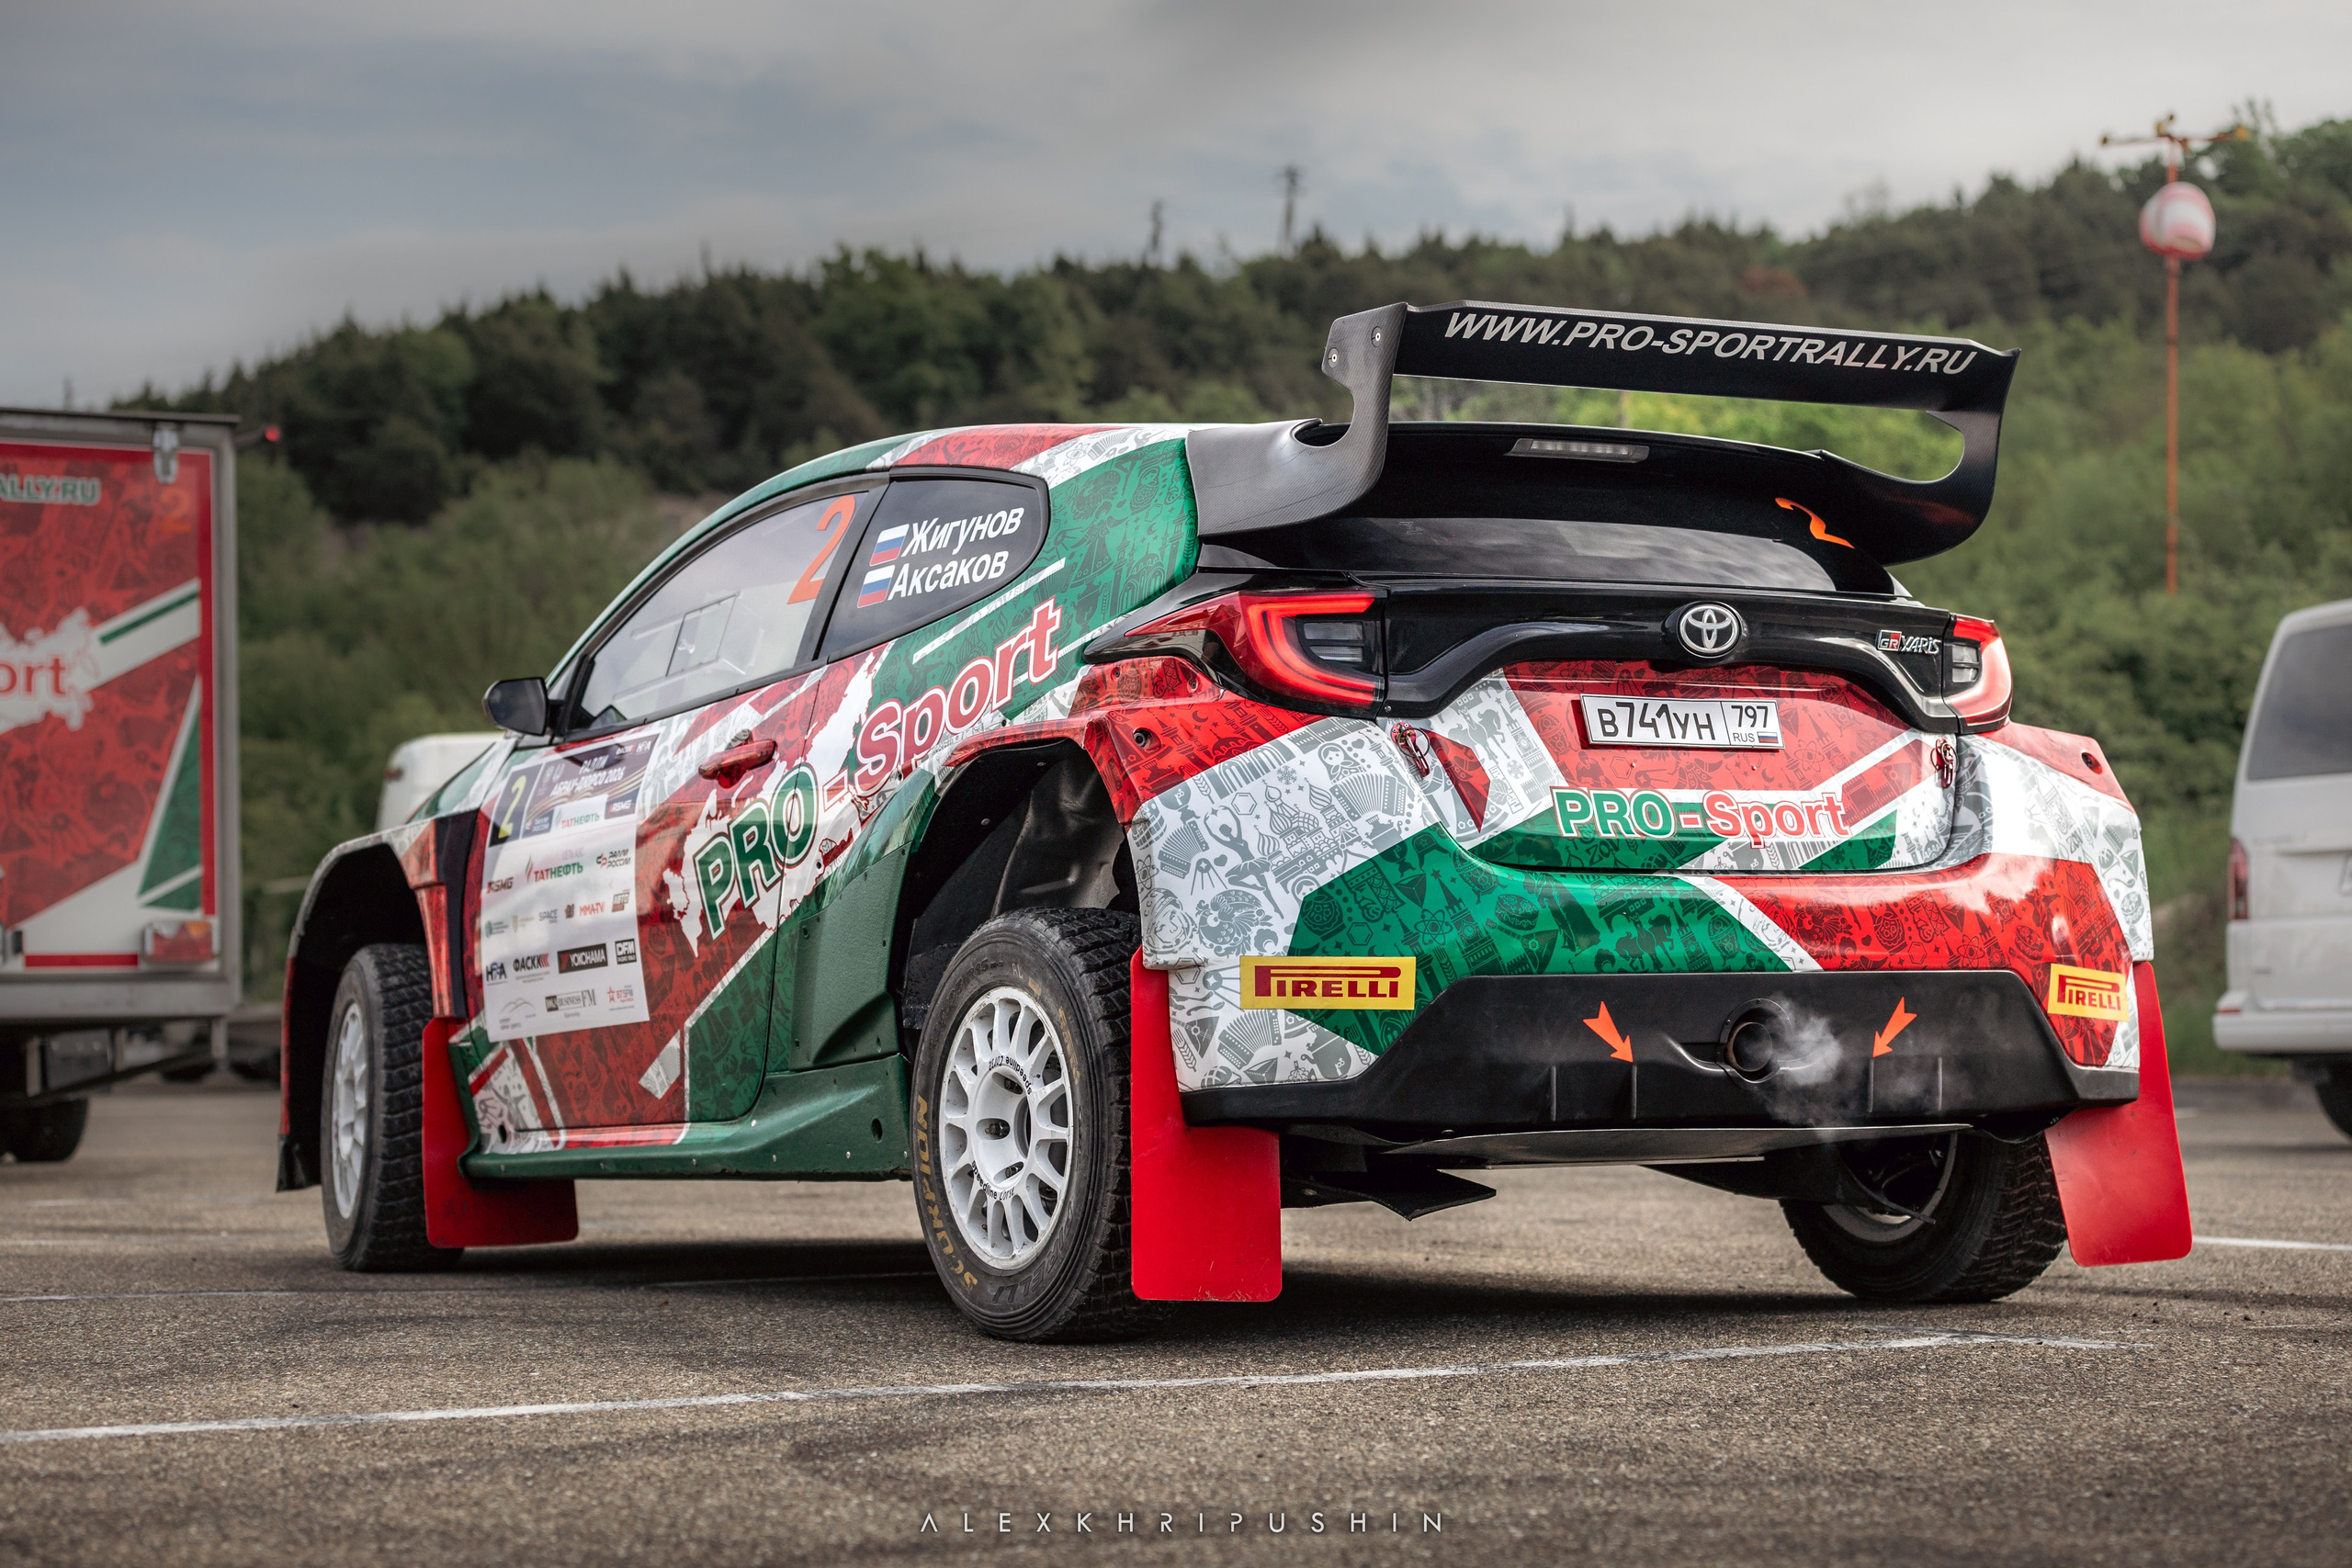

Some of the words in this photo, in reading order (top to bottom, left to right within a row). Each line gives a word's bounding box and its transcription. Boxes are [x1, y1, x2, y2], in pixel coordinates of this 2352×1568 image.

[1443, 311, 1977, 375] WWW.PRO-SPORTRALLY.RU
[786, 494, 856, 605] 2
[900, 506, 1025, 558] Жигунов
[887, 550, 1009, 601] Аксаков
[1879, 637, 1901, 650] GR
[1900, 635, 1941, 655] YARIS
[1598, 701, 1717, 741] В741УН
[1731, 705, 1770, 728] 797
[1733, 732, 1756, 743] RUS
[692, 595, 1063, 942] PRO-Sport
[498, 775, 527, 840] 2
[561, 813, 600, 829] ТАТНЕФТЬ
[1550, 784, 1851, 849] PRO-Sport
[534, 862, 583, 882] ТАТНЕФТЬ
[513, 953, 543, 972] ФАСКК
[570, 948, 606, 967] YOKOHAMA
[616, 941, 635, 956] DFM
[1254, 964, 1401, 998] PIRELLI
[2056, 974, 2122, 1011] PIRELLI
